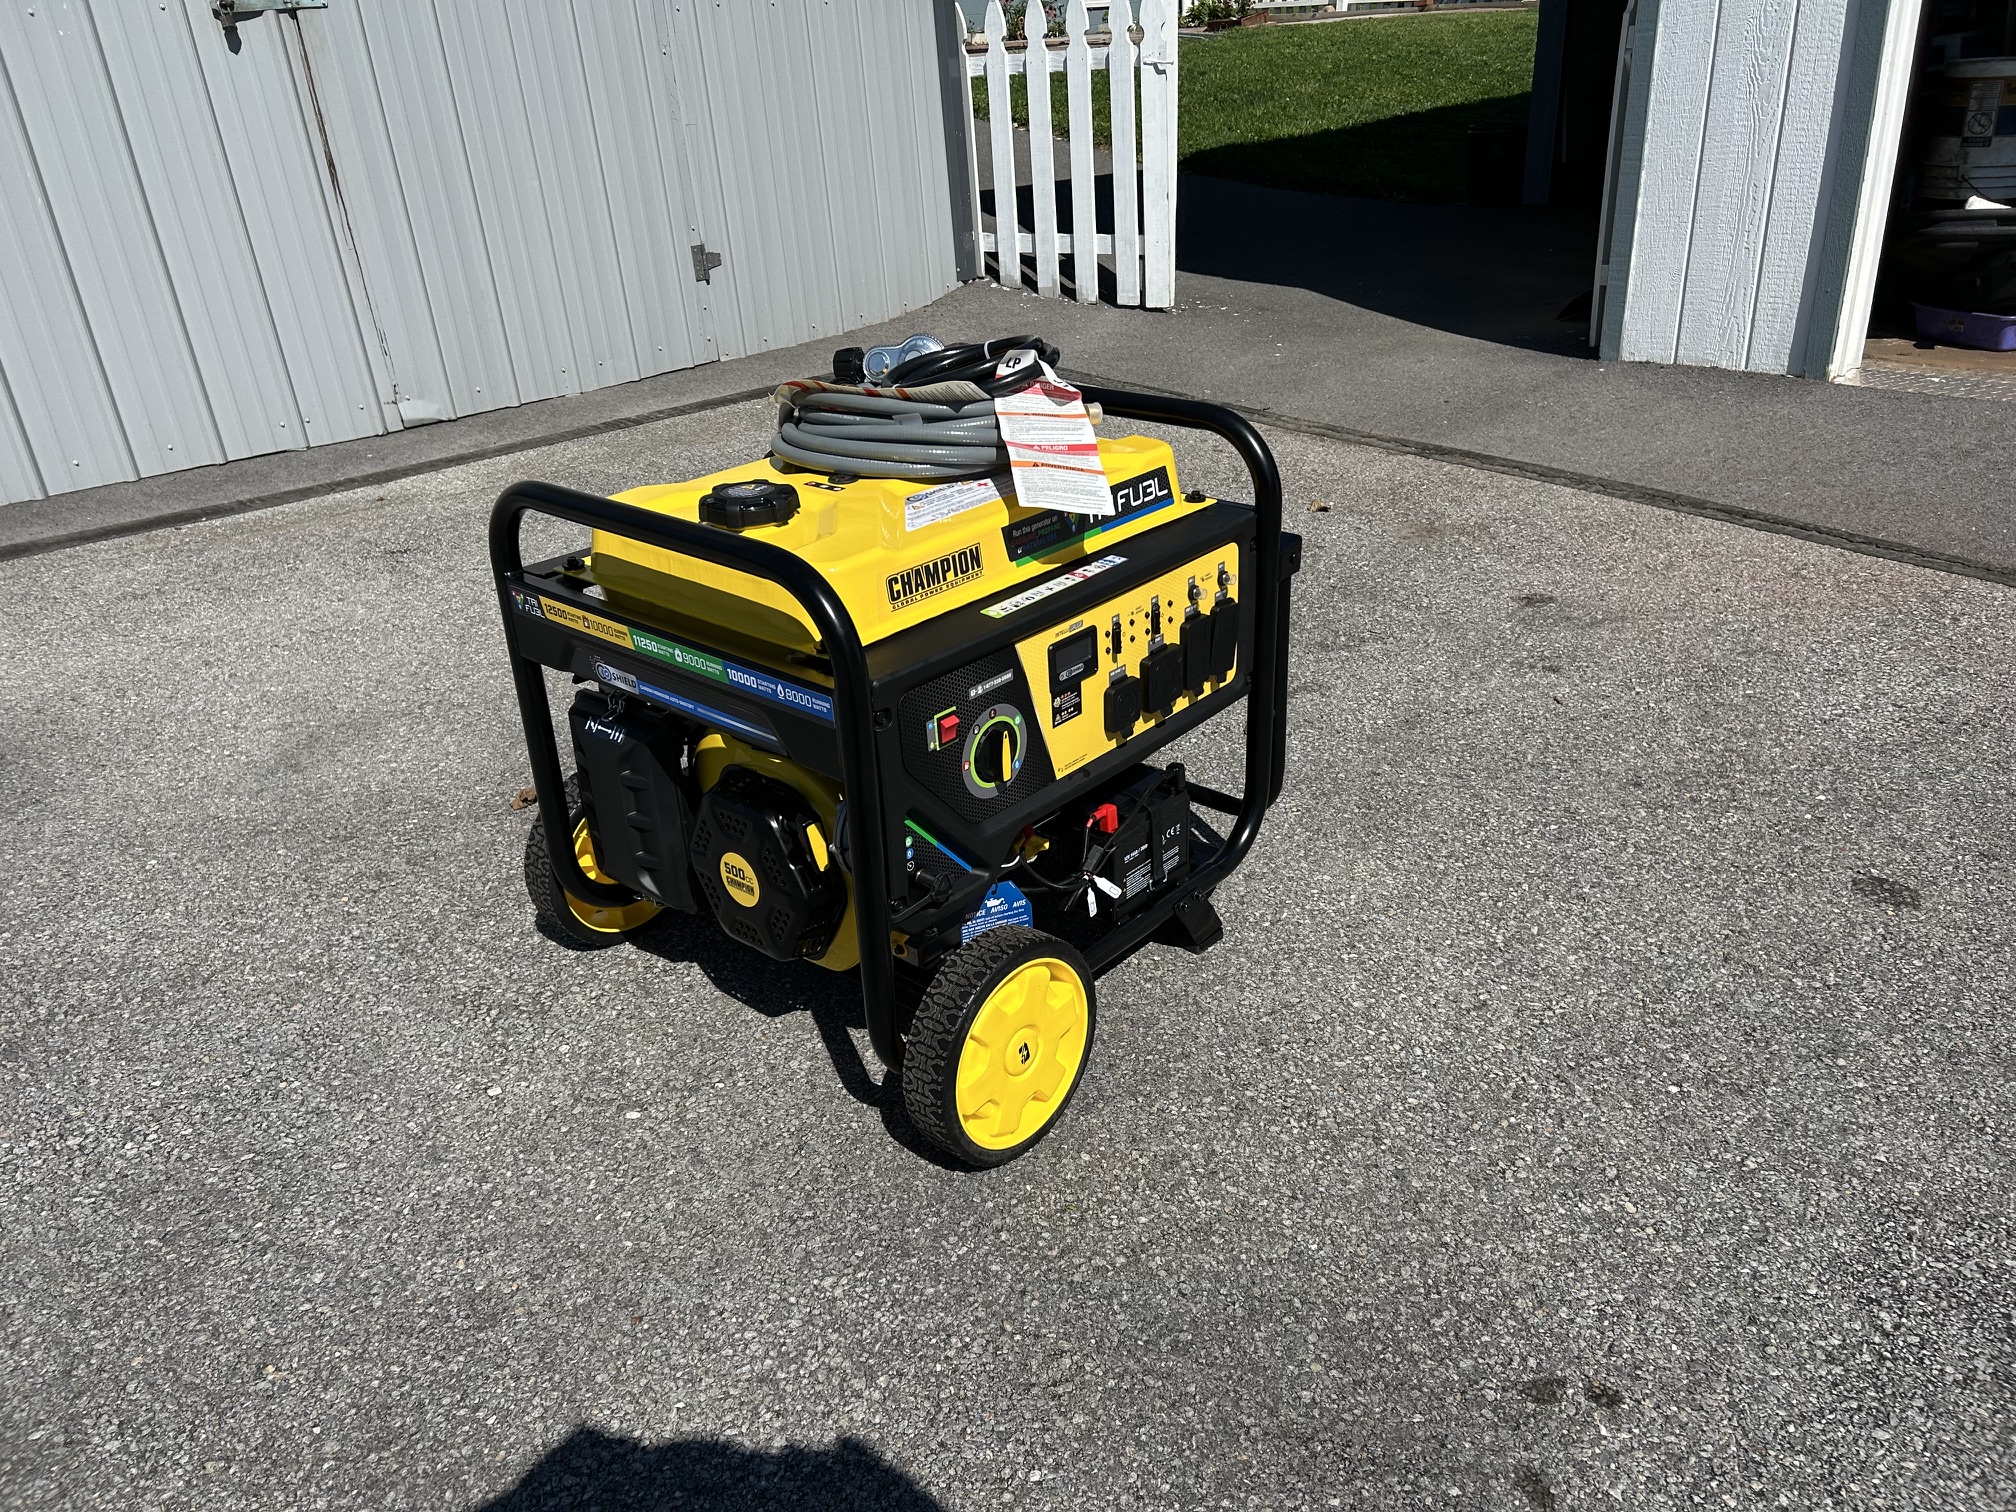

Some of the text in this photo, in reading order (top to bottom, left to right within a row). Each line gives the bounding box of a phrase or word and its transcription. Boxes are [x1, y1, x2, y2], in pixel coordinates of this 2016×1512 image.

[1005, 357, 1022, 369] LP
[1040, 462, 1085, 473] ADVERTENCIA
[1012, 515, 1058, 538] Run this generator on
[887, 544, 982, 603] CHAMPION
[892, 571, 983, 610] GLOBAL POWER EQUIPMENT
[526, 596, 539, 608] TRI
[544, 603, 568, 620] 12500
[589, 620, 613, 636] 10000
[633, 635, 658, 652] 11250
[683, 652, 706, 670] 9000
[612, 673, 637, 689] SHIELD
[727, 668, 757, 688] 10000
[785, 688, 812, 707] 8000
[965, 899, 1026, 920] NOTICE AVISO AVIS
